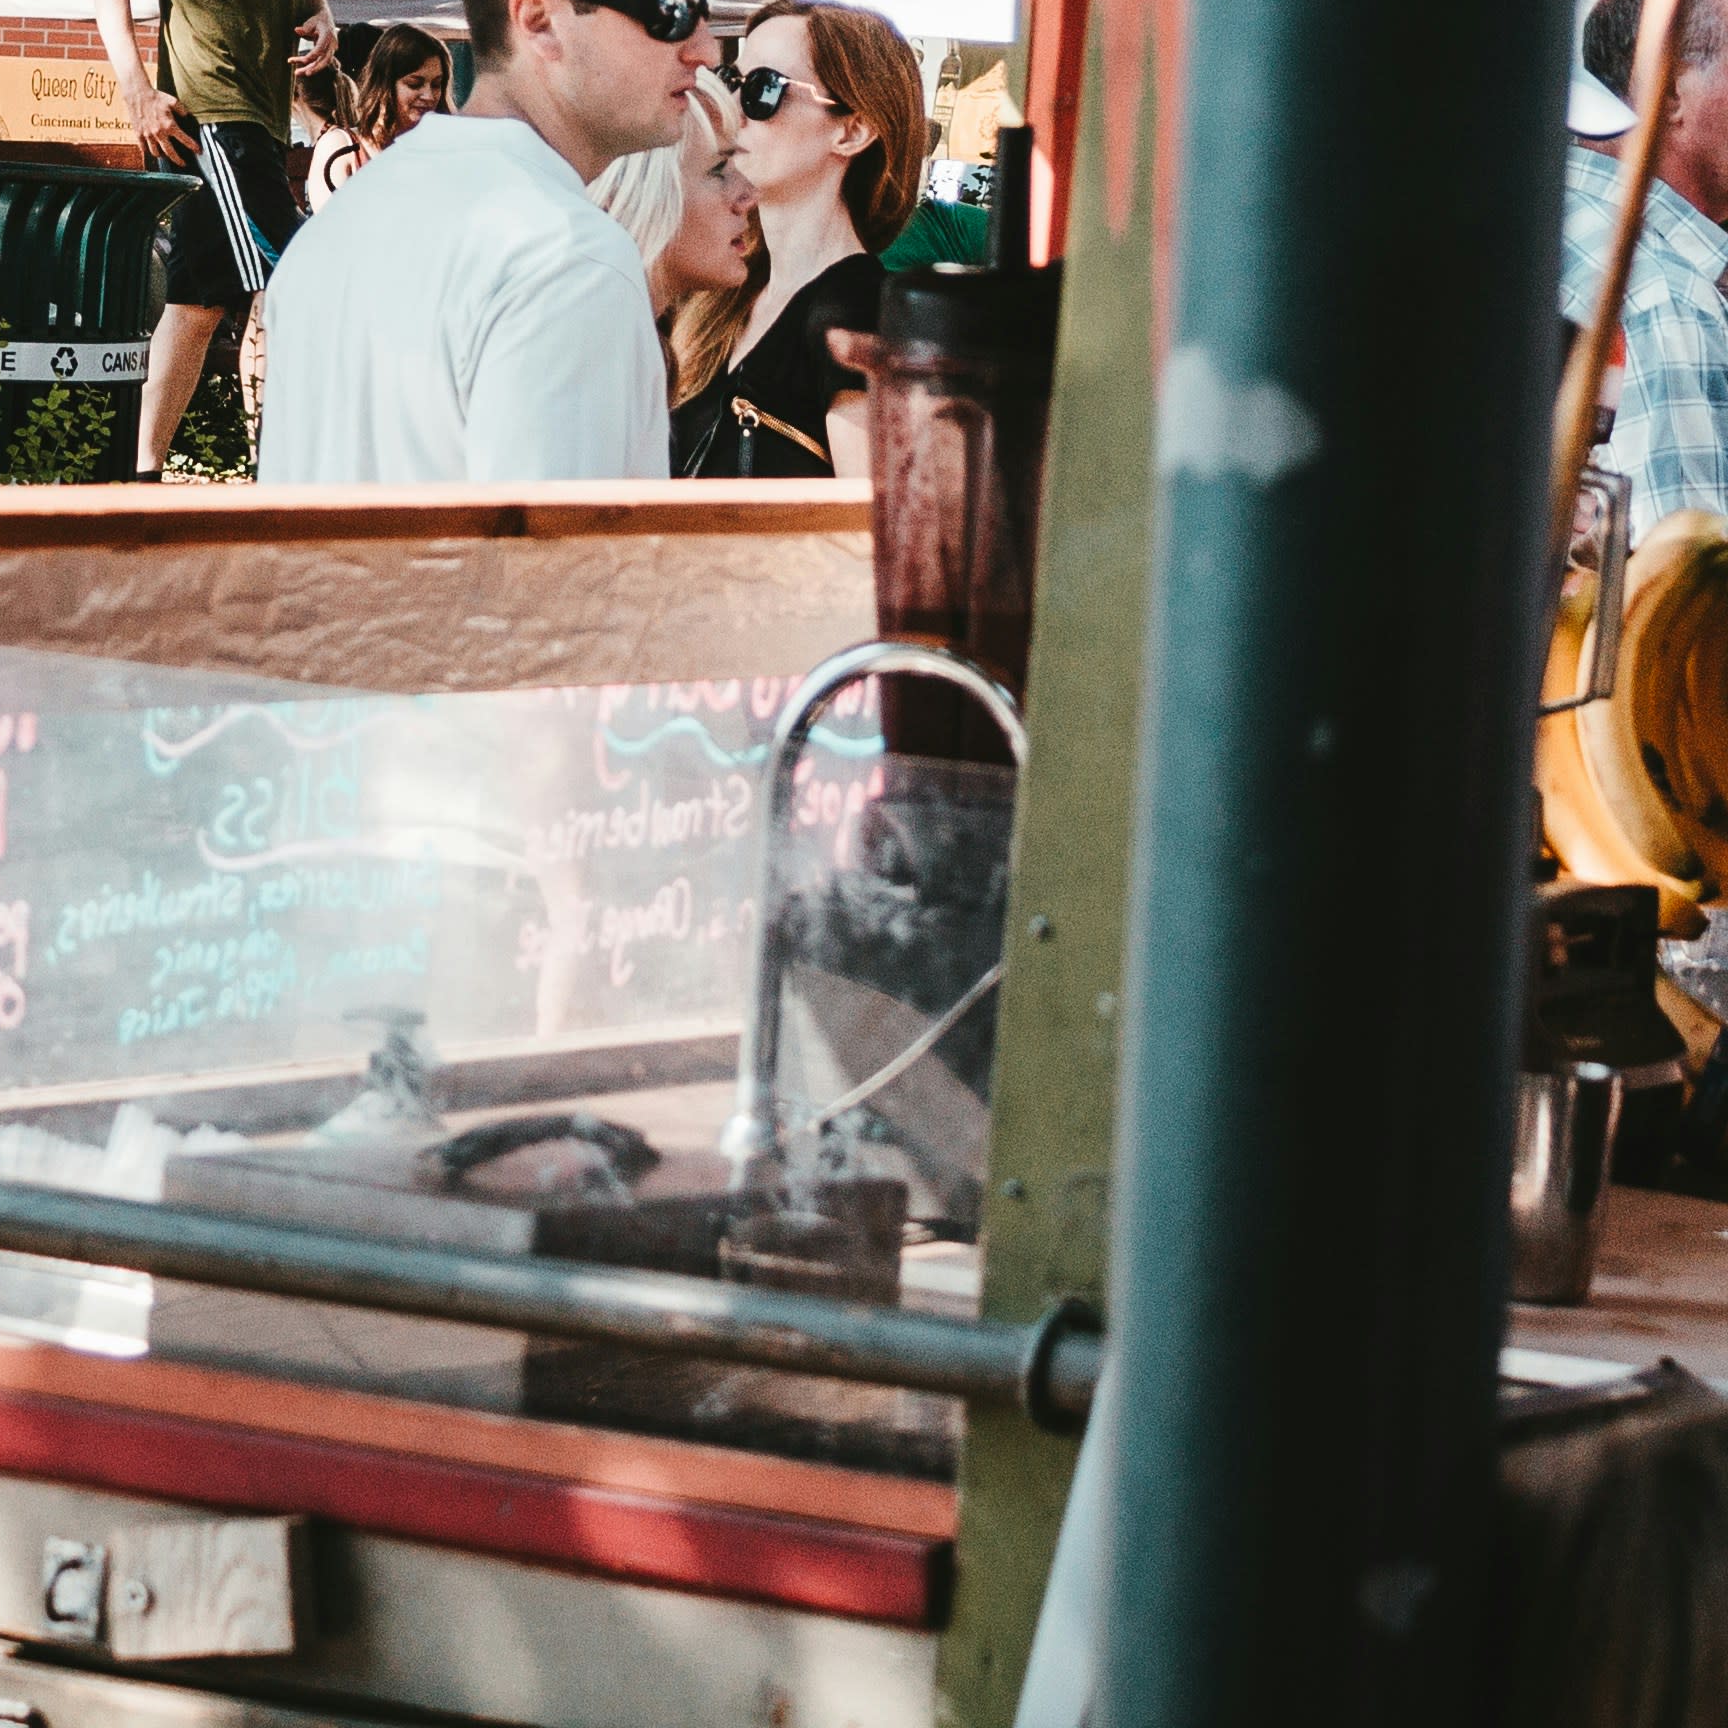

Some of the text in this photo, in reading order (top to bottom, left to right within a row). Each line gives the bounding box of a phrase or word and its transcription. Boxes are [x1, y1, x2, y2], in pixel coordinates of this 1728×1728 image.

[31, 68, 117, 106] Queen City
[31, 113, 91, 129] Cincinnati
[102, 351, 138, 373] CANS
